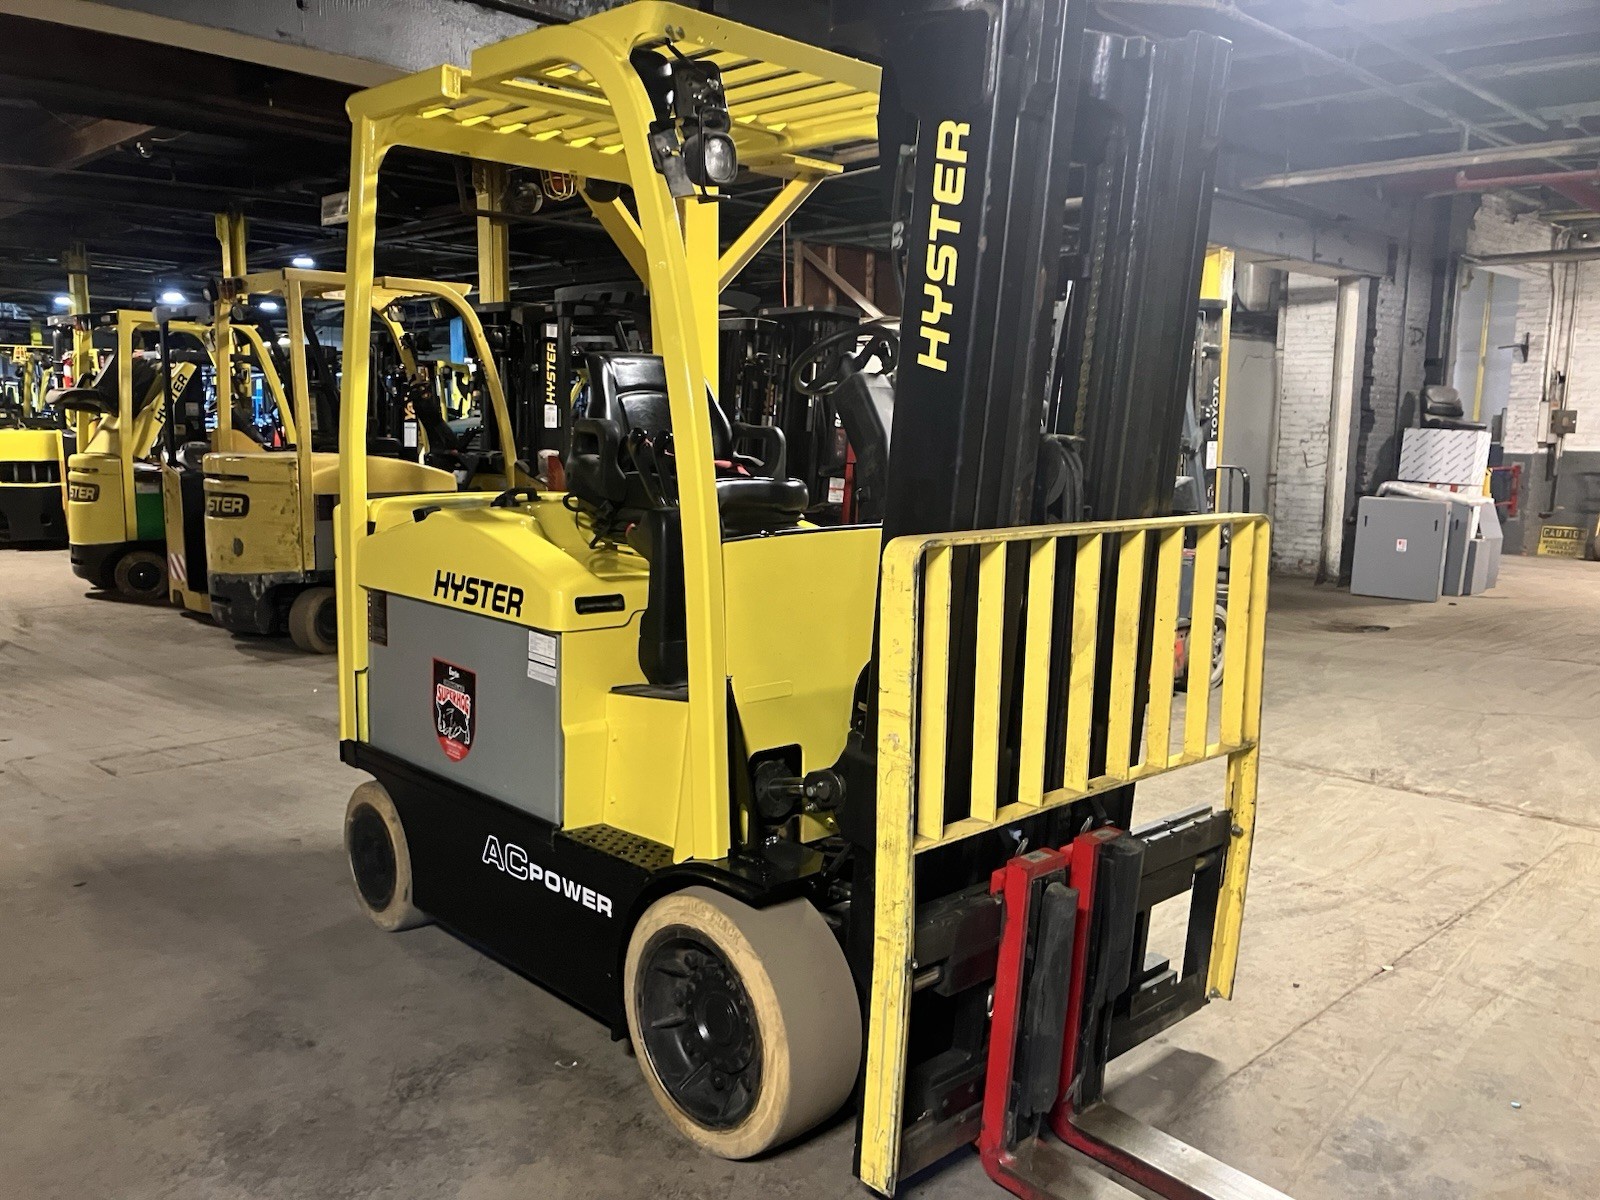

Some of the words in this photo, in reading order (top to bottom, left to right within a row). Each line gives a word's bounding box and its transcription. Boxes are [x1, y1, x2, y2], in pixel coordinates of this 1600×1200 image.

[916, 119, 971, 373] HYSTER
[154, 373, 188, 425] HYTER
[545, 341, 557, 405] HYSTER
[1210, 376, 1220, 439] TOYOTA
[1543, 528, 1582, 540] CAUTIO
[433, 569, 525, 618] HYSTER
[482, 834, 529, 881] AC
[528, 861, 613, 919] POWER
